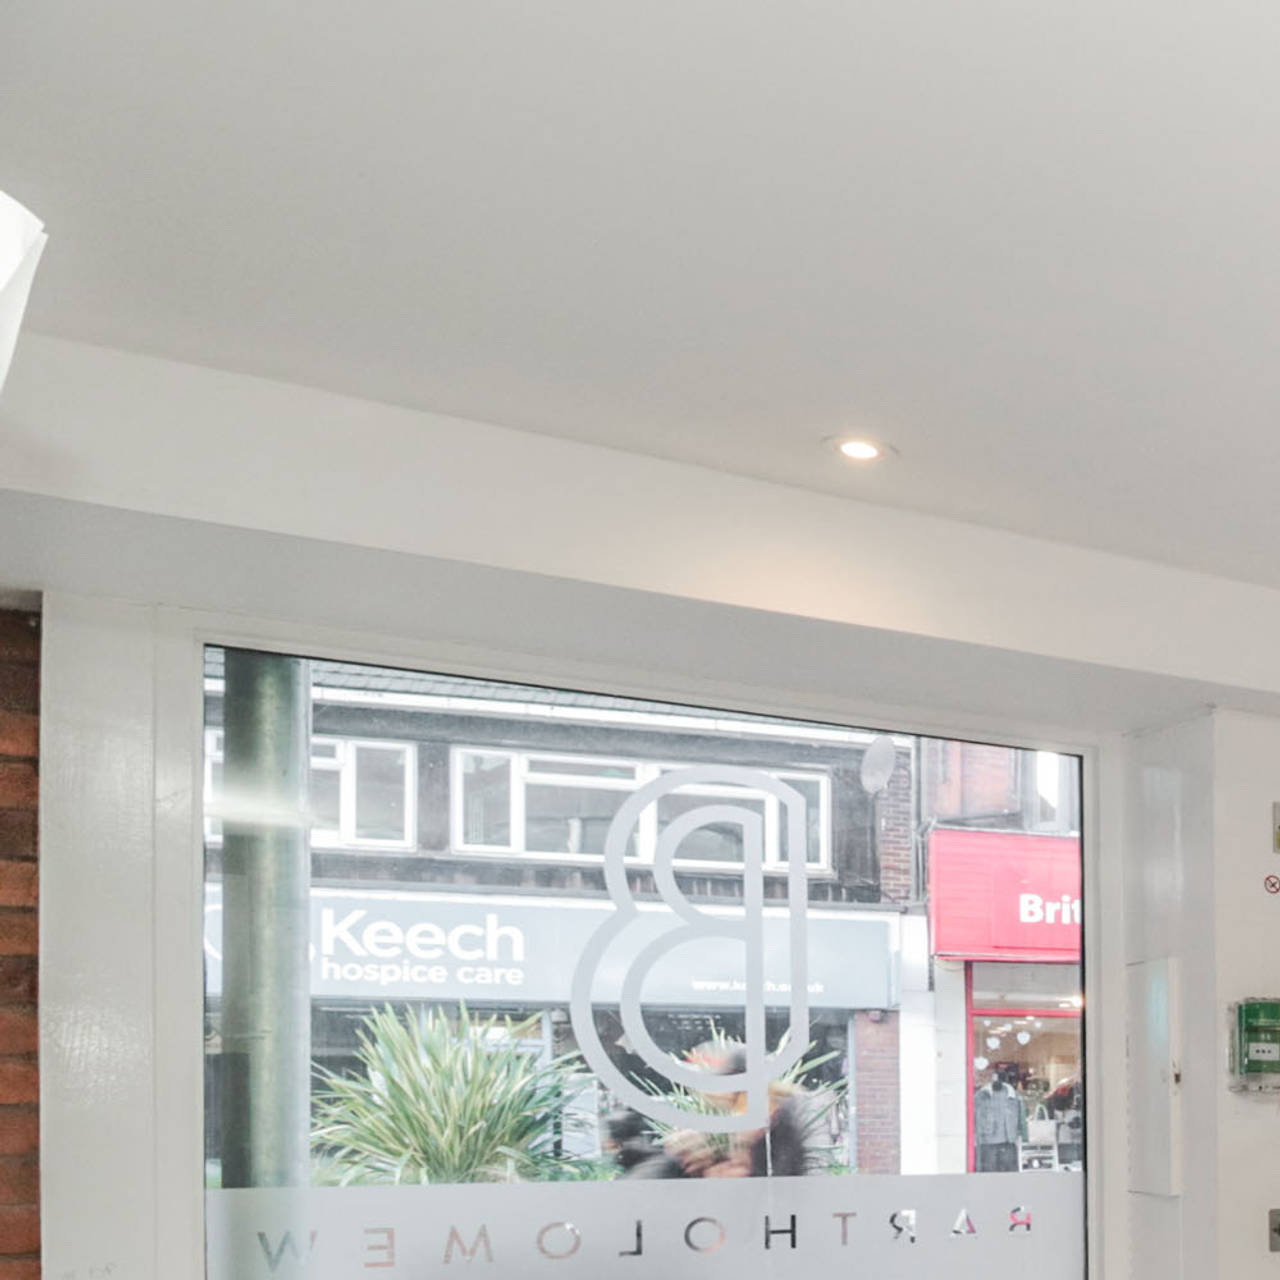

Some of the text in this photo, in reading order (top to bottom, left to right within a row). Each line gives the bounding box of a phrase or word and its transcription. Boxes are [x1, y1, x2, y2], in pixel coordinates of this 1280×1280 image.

[1019, 893, 1082, 925] Brit
[321, 908, 525, 961] Keech
[321, 957, 525, 986] hospice care
